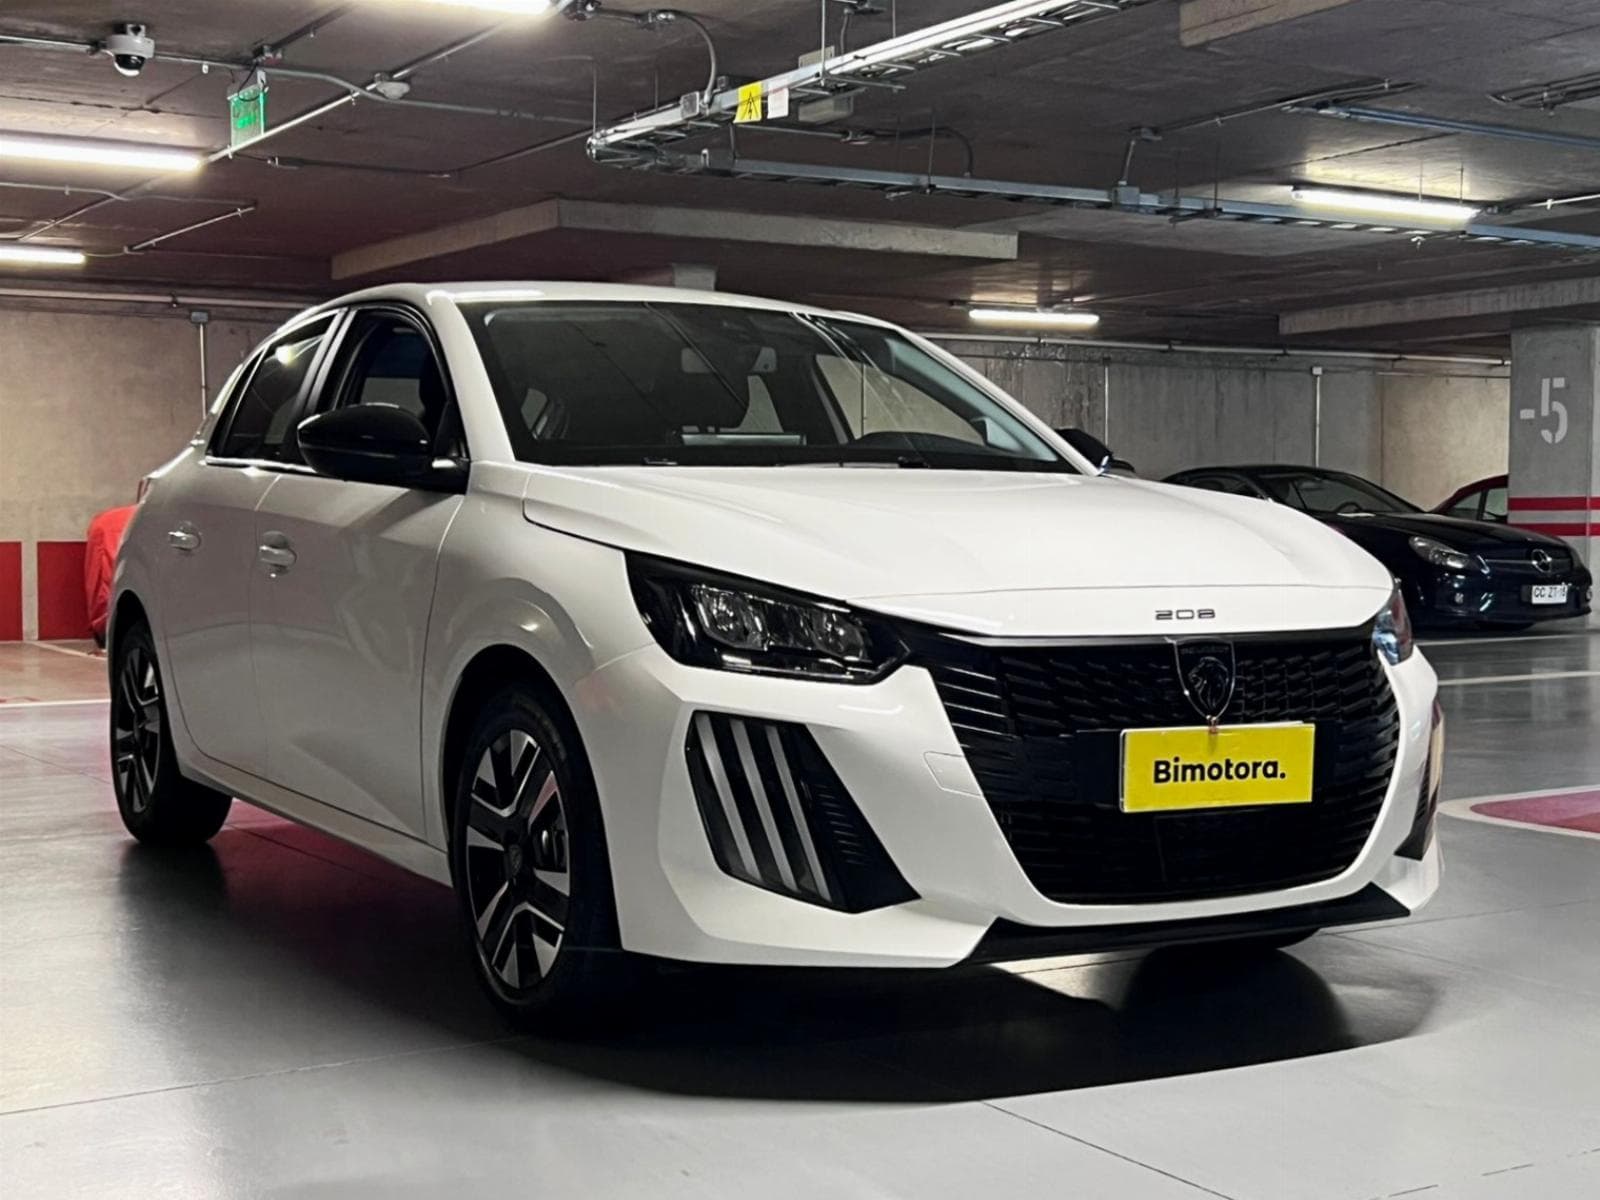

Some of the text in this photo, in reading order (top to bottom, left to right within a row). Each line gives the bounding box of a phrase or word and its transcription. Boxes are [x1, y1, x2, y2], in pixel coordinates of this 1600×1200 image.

[1520, 377, 1567, 443] -5
[1155, 609, 1216, 620] 208
[1154, 756, 1286, 783] Bimotora.
